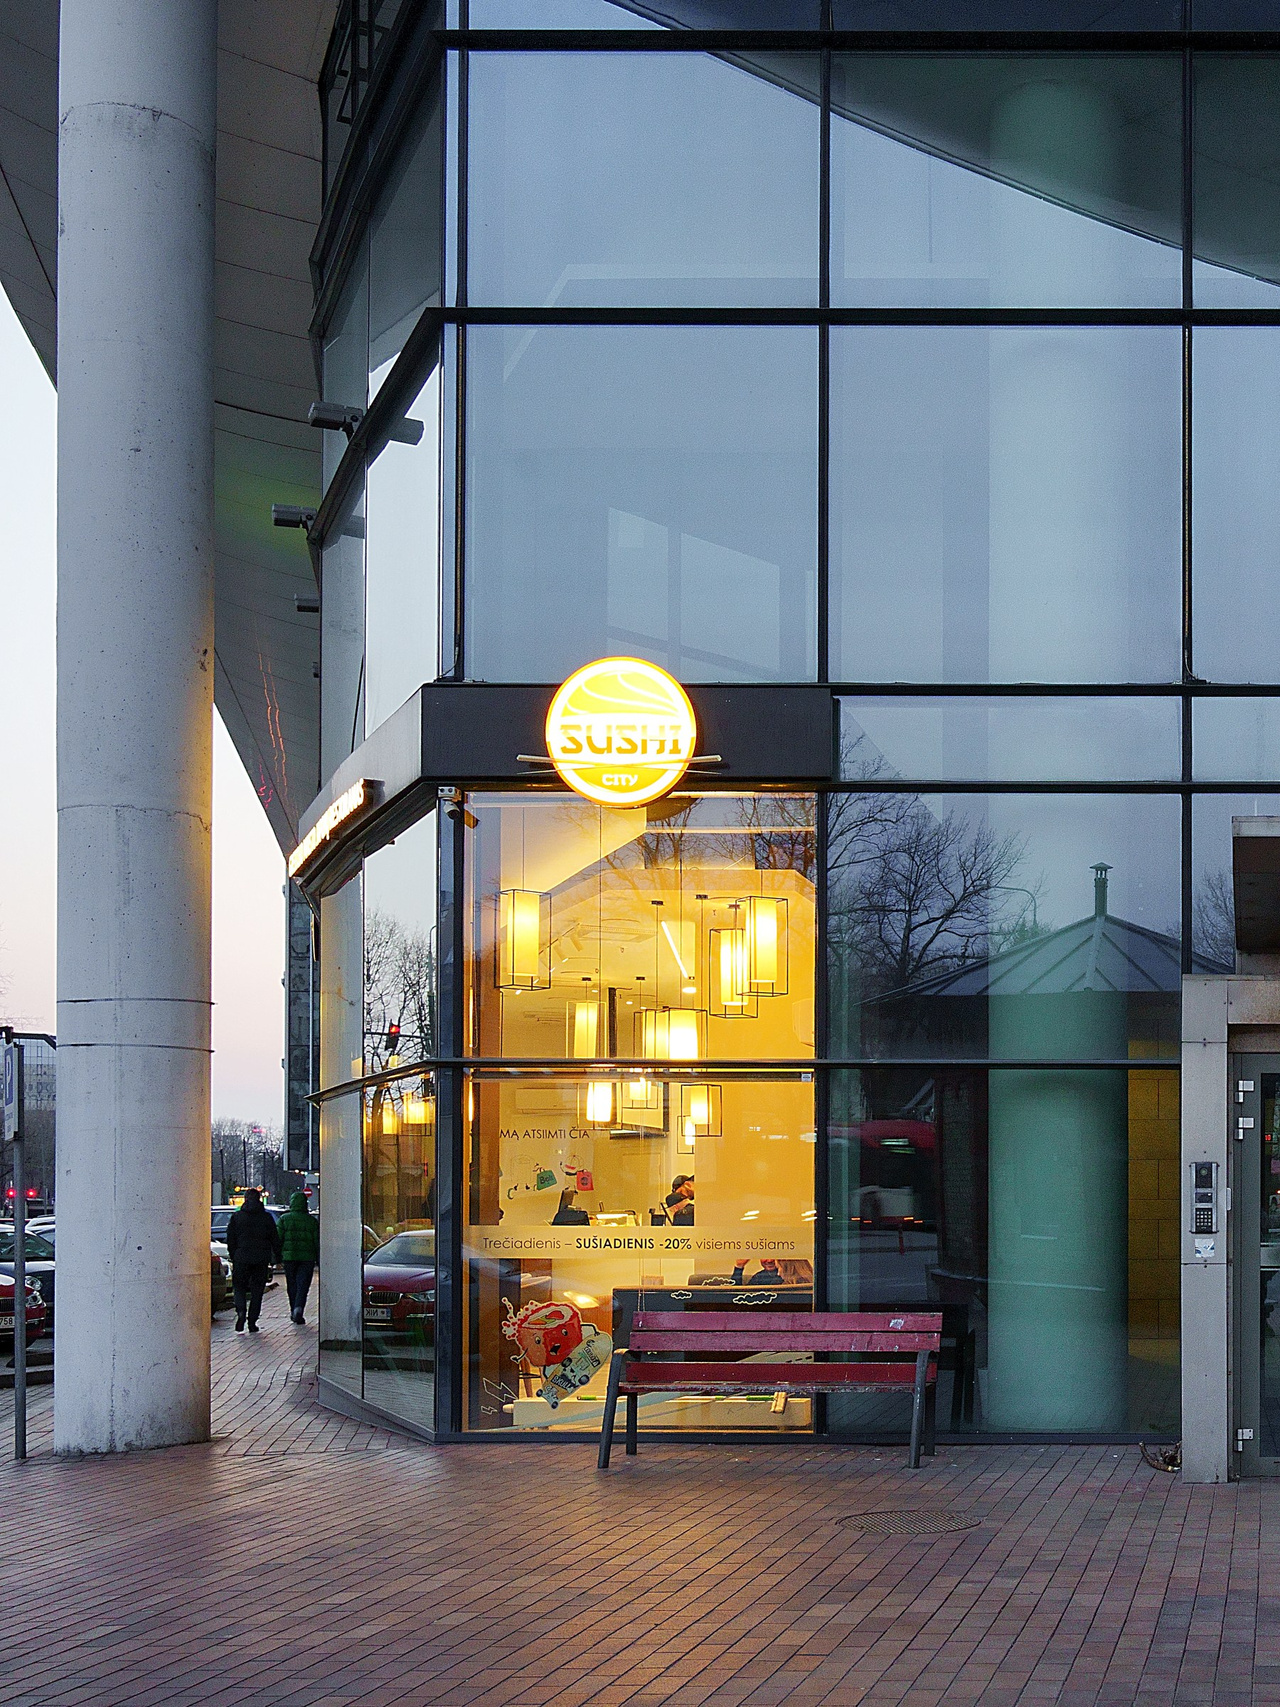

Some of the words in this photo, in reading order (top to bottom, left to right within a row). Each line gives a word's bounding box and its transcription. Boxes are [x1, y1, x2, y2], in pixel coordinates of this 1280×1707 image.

[560, 724, 682, 755] SUSHI
[602, 773, 639, 786] CITY
[6, 1054, 12, 1099] P
[522, 1129, 566, 1139] ATSIIMTI
[568, 1126, 590, 1139] ČIA
[483, 1237, 561, 1249] Trečiadienis
[575, 1235, 655, 1249] SUŠIADIENIS
[659, 1238, 692, 1250] -20%
[695, 1238, 742, 1250] visiems
[745, 1238, 795, 1250] sušiams
